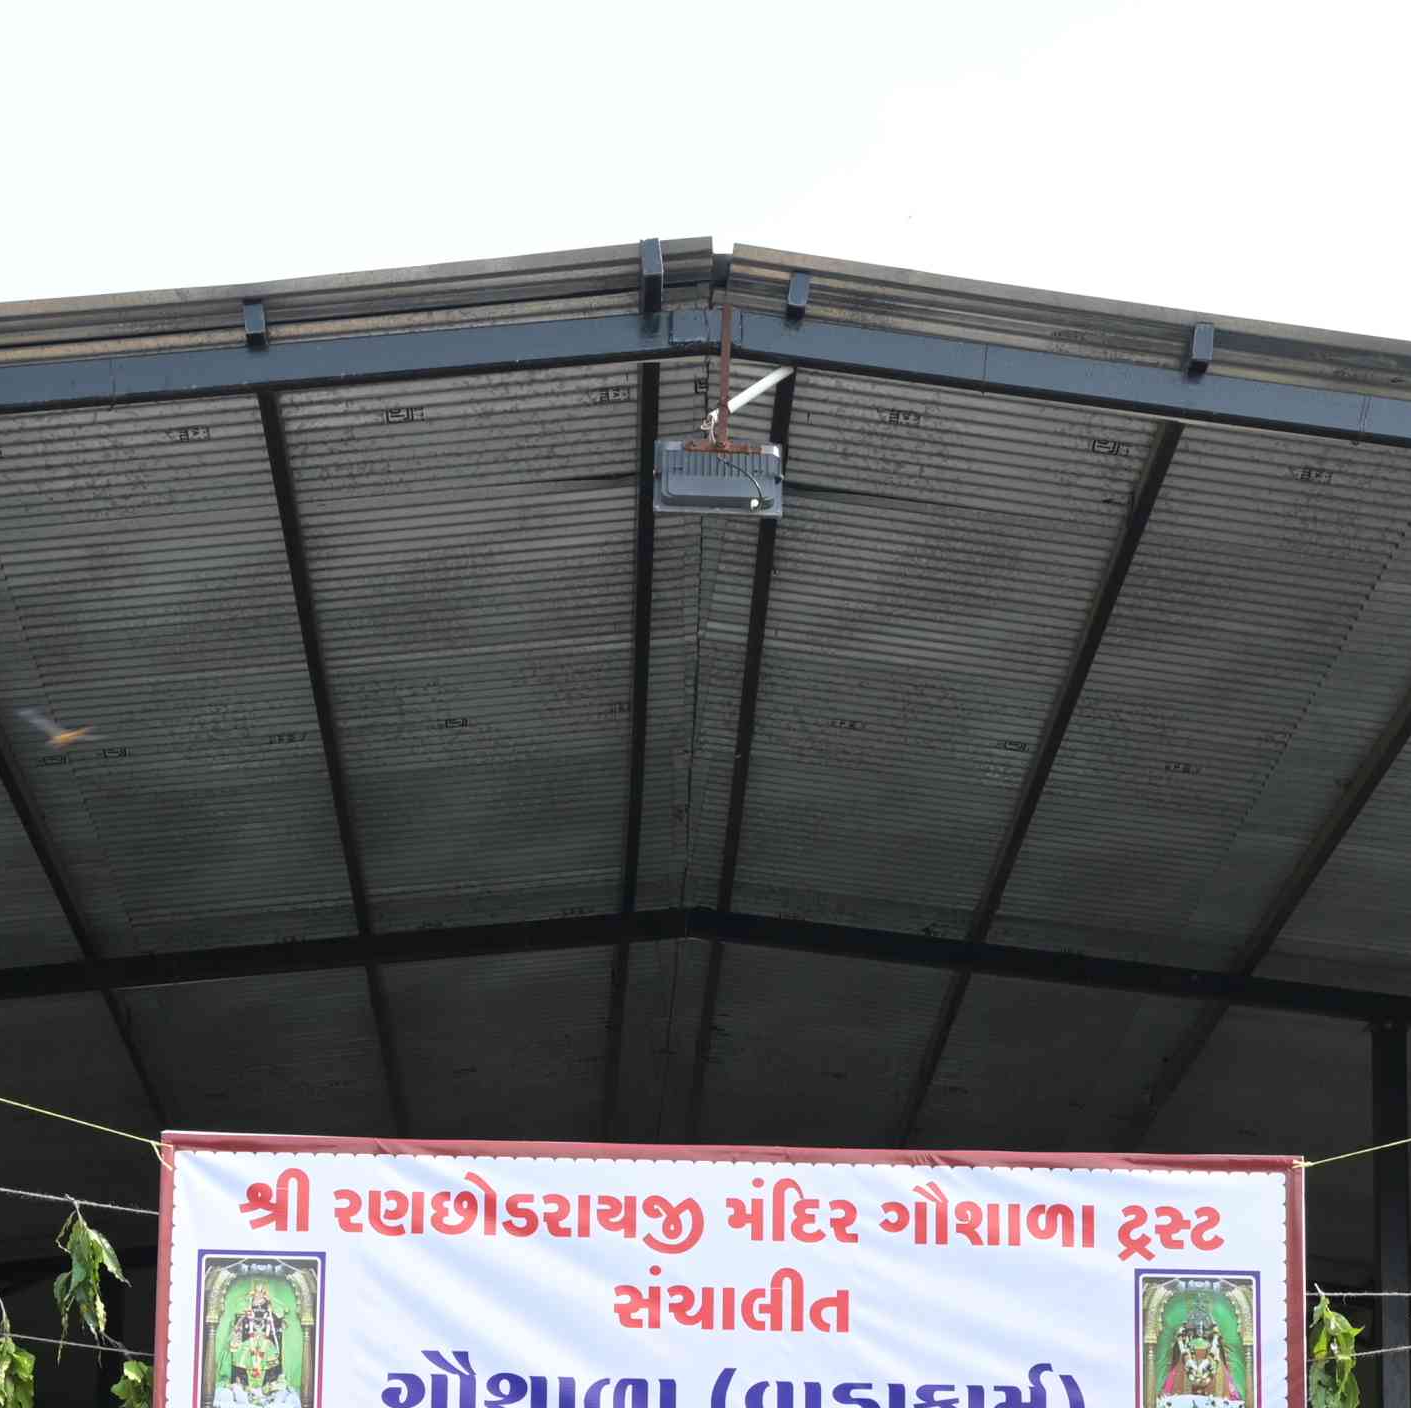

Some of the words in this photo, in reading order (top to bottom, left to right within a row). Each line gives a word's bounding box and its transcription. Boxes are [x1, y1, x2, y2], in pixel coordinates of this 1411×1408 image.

[240, 1167, 310, 1233] શ્રી
[333, 1171, 705, 1255] રણછોડરાયજી
[726, 1177, 860, 1244] મંદિર
[880, 1183, 1096, 1249] ગૌશાળા
[1118, 1204, 1224, 1261] ટ્રસ્ટ
[614, 1265, 851, 1334] સંચાલીત
